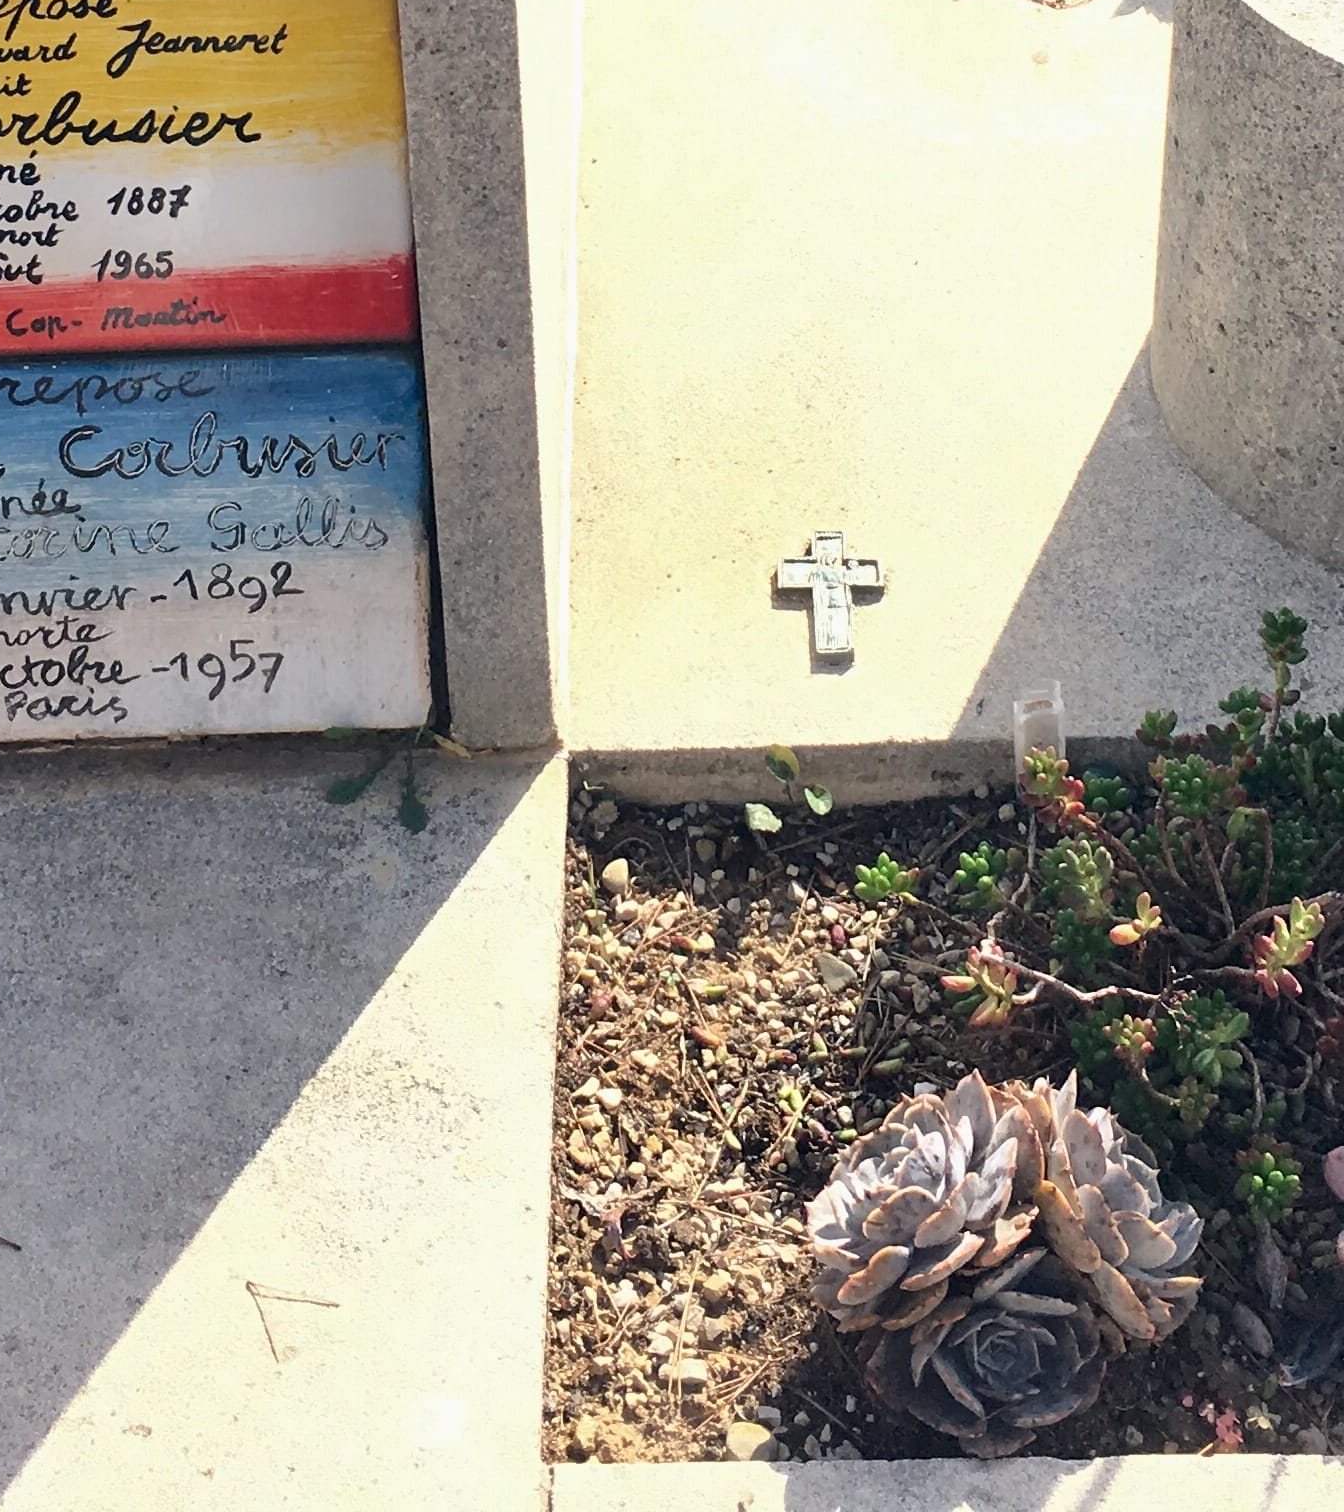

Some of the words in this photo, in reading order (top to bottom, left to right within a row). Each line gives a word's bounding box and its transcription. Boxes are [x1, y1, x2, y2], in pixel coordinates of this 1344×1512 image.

[106, 19, 289, 79] Jeanneret
[107, 185, 191, 217] 1887
[91, 250, 175, 282] 1965
[58, 410, 407, 480] Corbusier
[1, 478, 82, 519] née
[207, 495, 390, 554] Gallis
[3, 689, 130, 723] Paris
